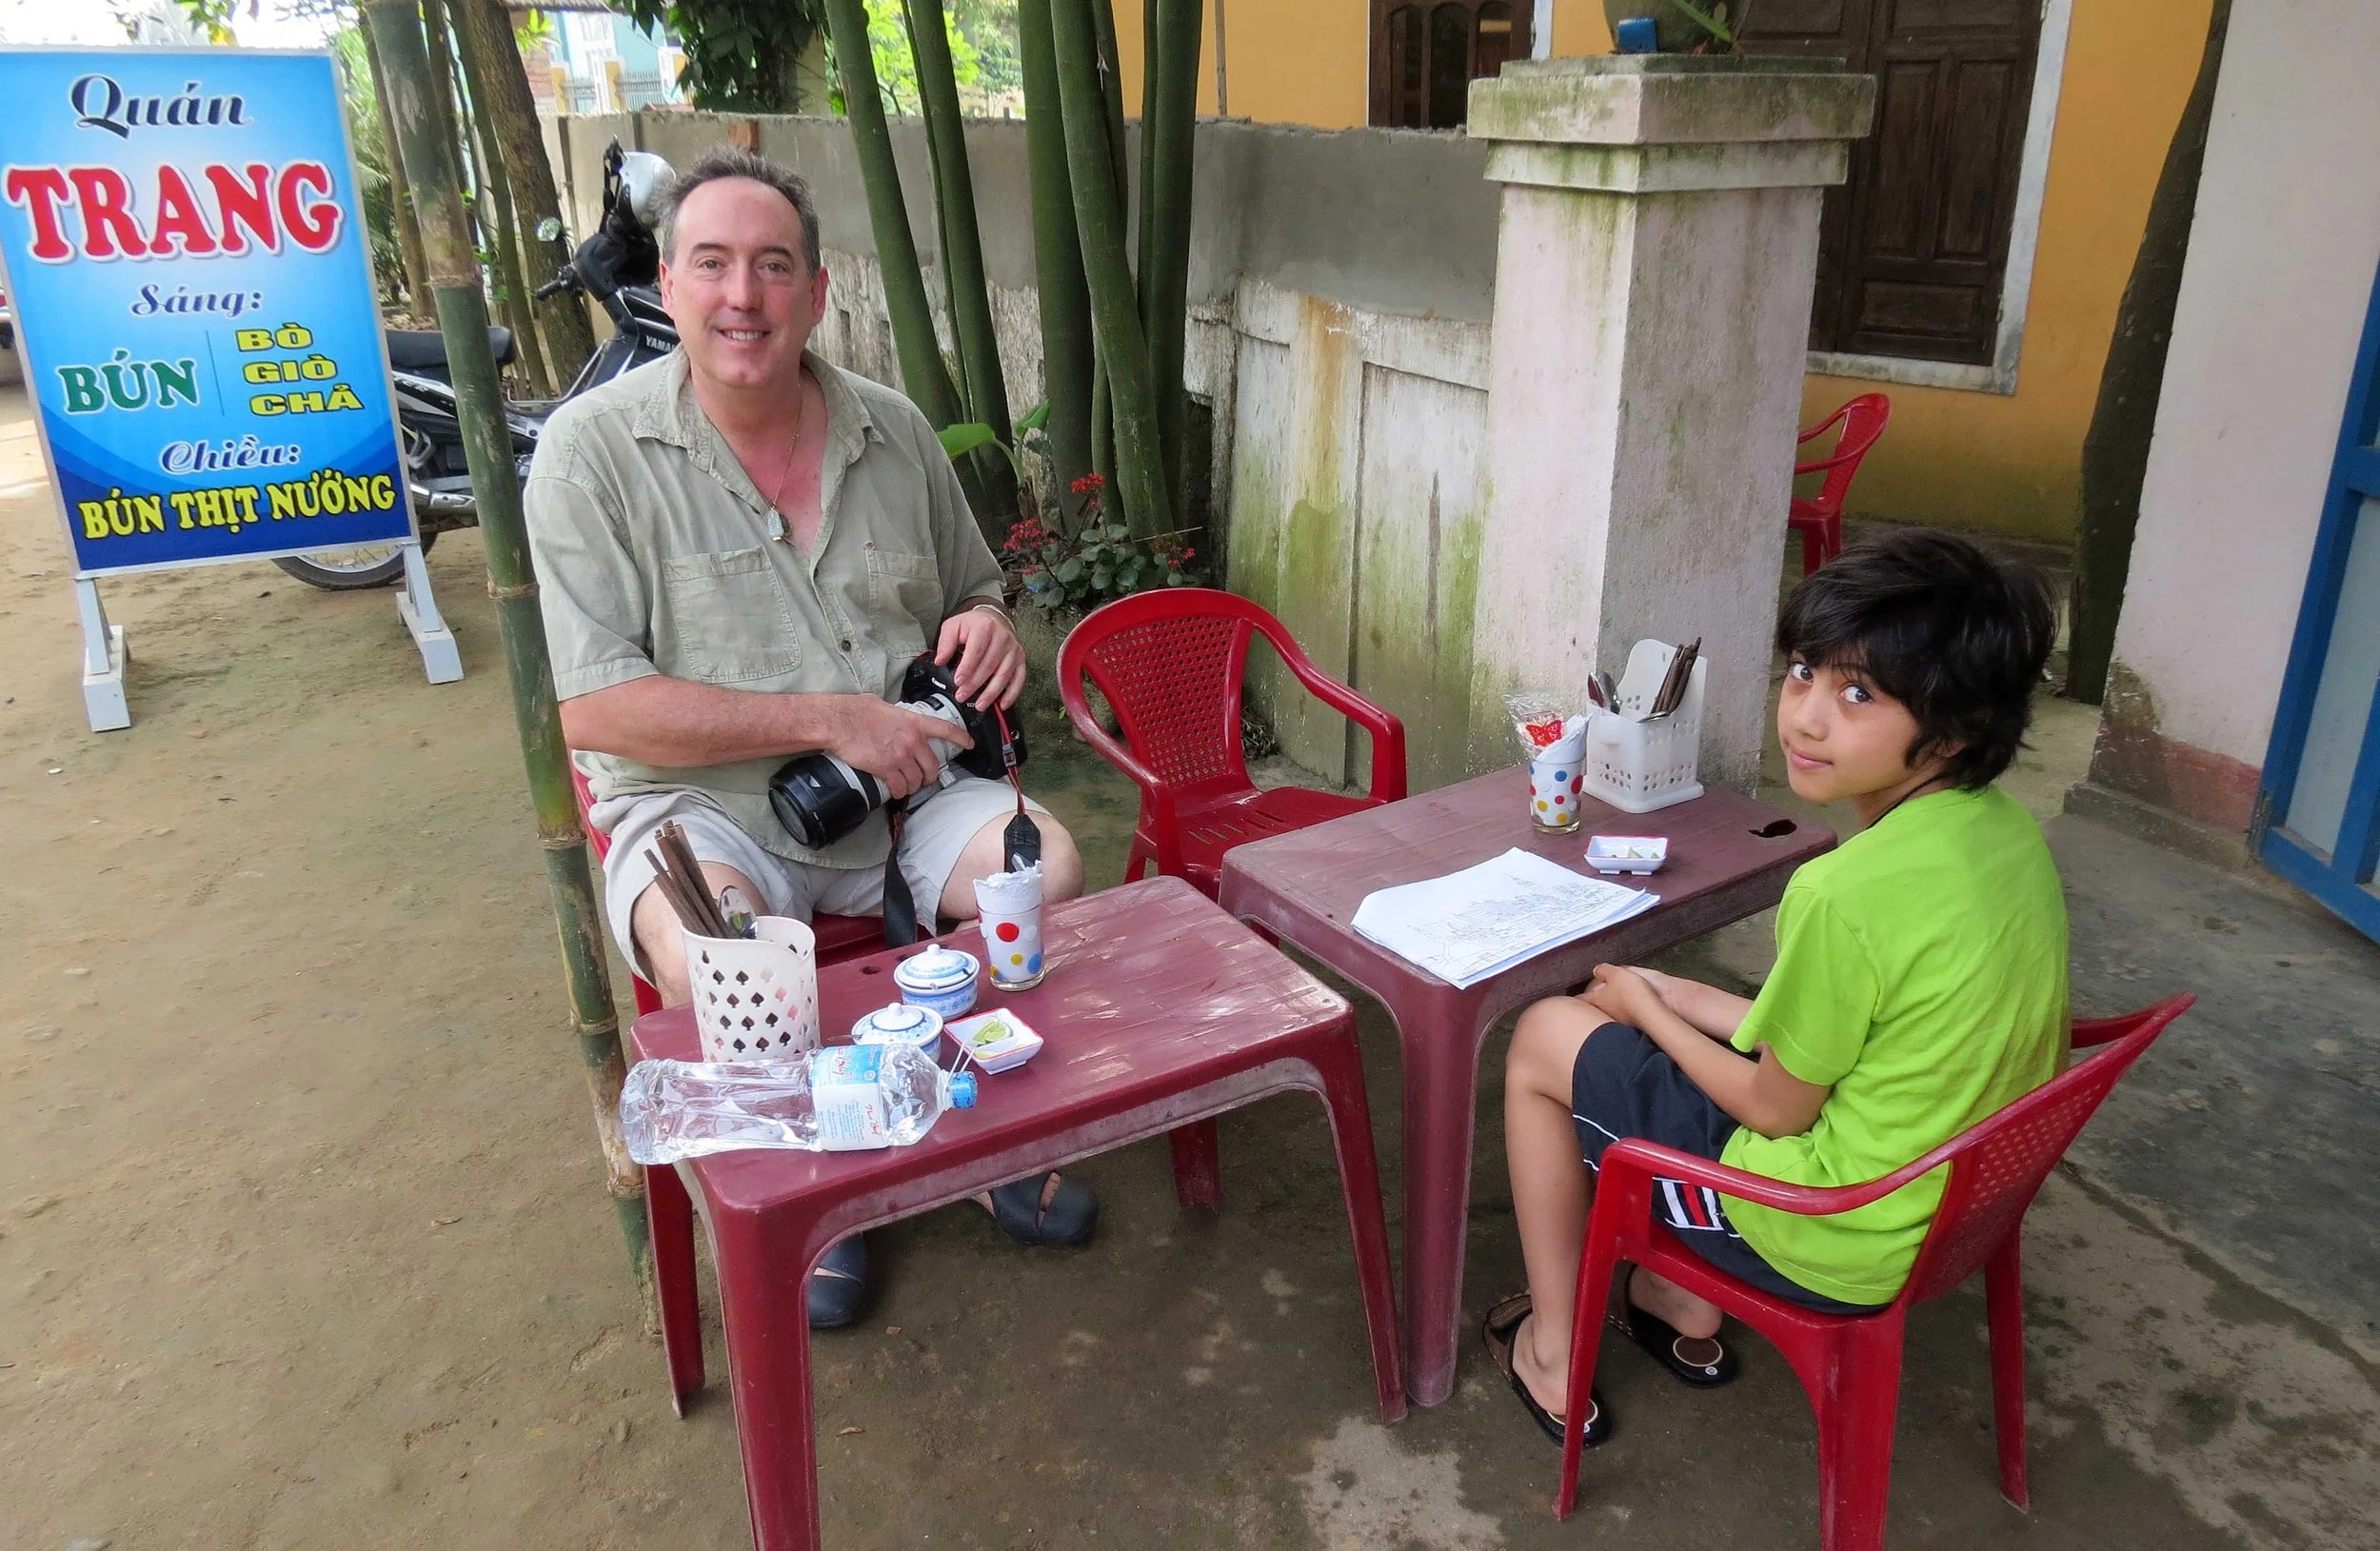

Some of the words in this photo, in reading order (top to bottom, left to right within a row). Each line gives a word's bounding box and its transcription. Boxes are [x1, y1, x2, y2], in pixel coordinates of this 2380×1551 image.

[71, 75, 250, 138] Quán
[6, 162, 341, 260] TRANG
[132, 284, 262, 317] Sáng:
[236, 323, 313, 351] BÒ
[59, 349, 197, 412] BÚN
[243, 354, 338, 384] GIÒ
[249, 384, 363, 416] CHẢ
[162, 434, 300, 472] Chiều:
[79, 487, 166, 540] BÚN
[169, 485, 260, 534] THỊT
[266, 468, 396, 520] NƯỚNG
